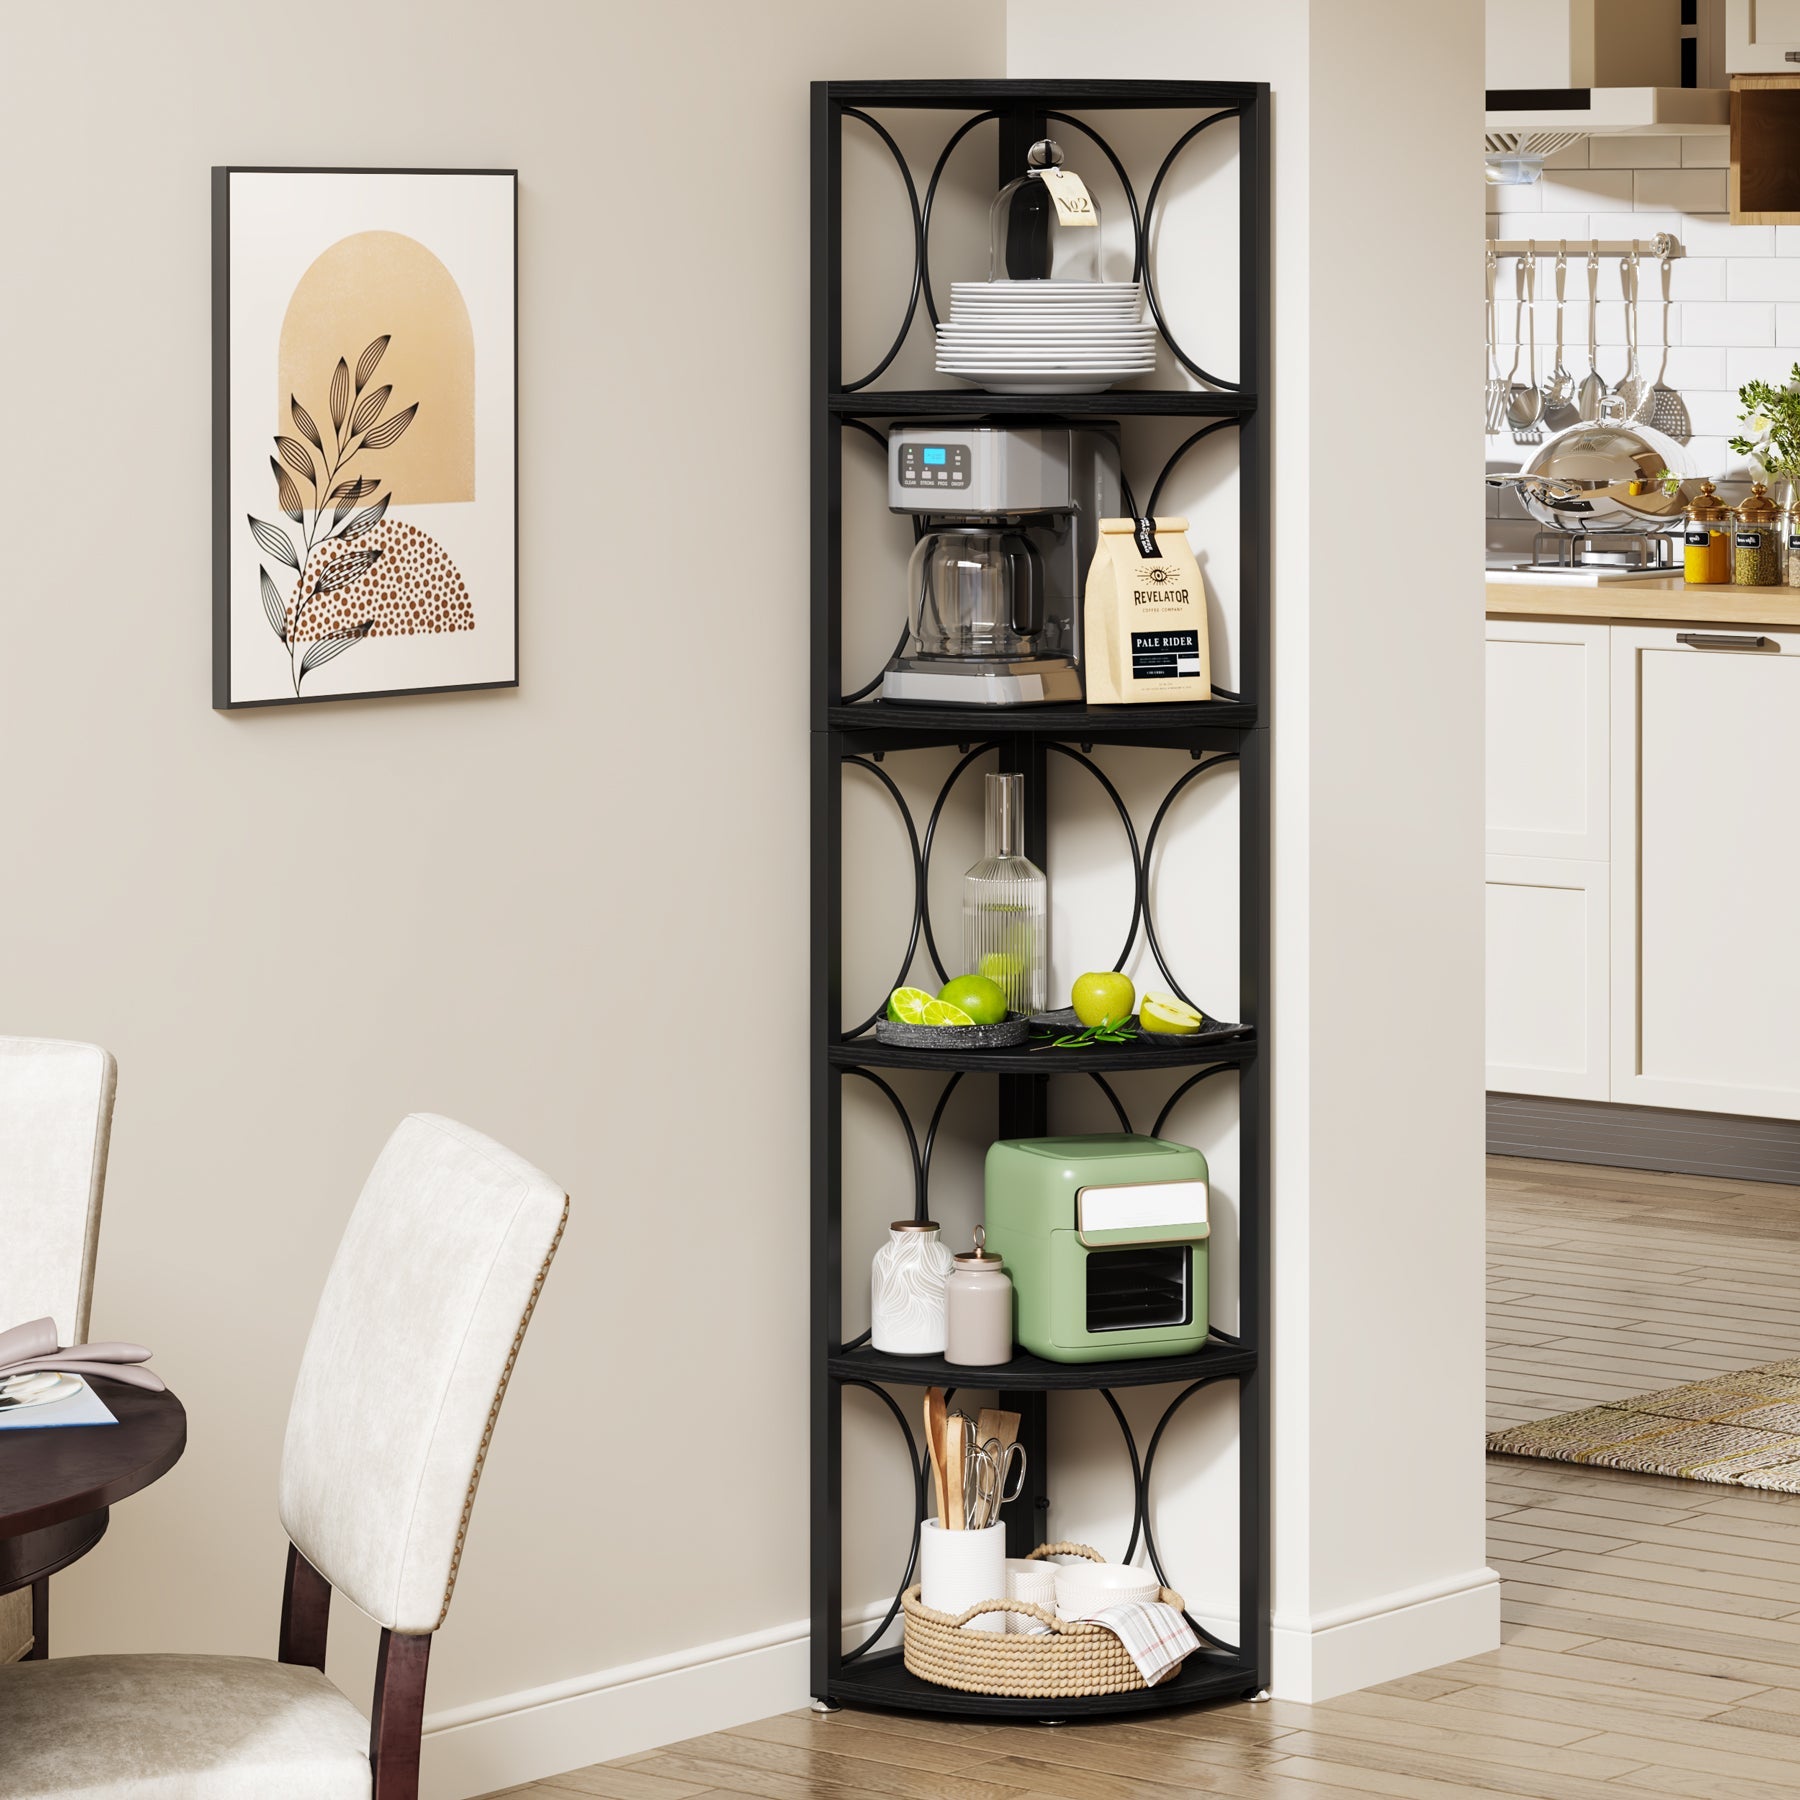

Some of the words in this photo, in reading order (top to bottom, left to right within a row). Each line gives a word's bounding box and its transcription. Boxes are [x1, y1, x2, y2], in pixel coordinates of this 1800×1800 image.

[1133, 589, 1190, 606] REVELATOR
[1136, 638, 1161, 648] PALE
[1162, 636, 1193, 647] RIDER
